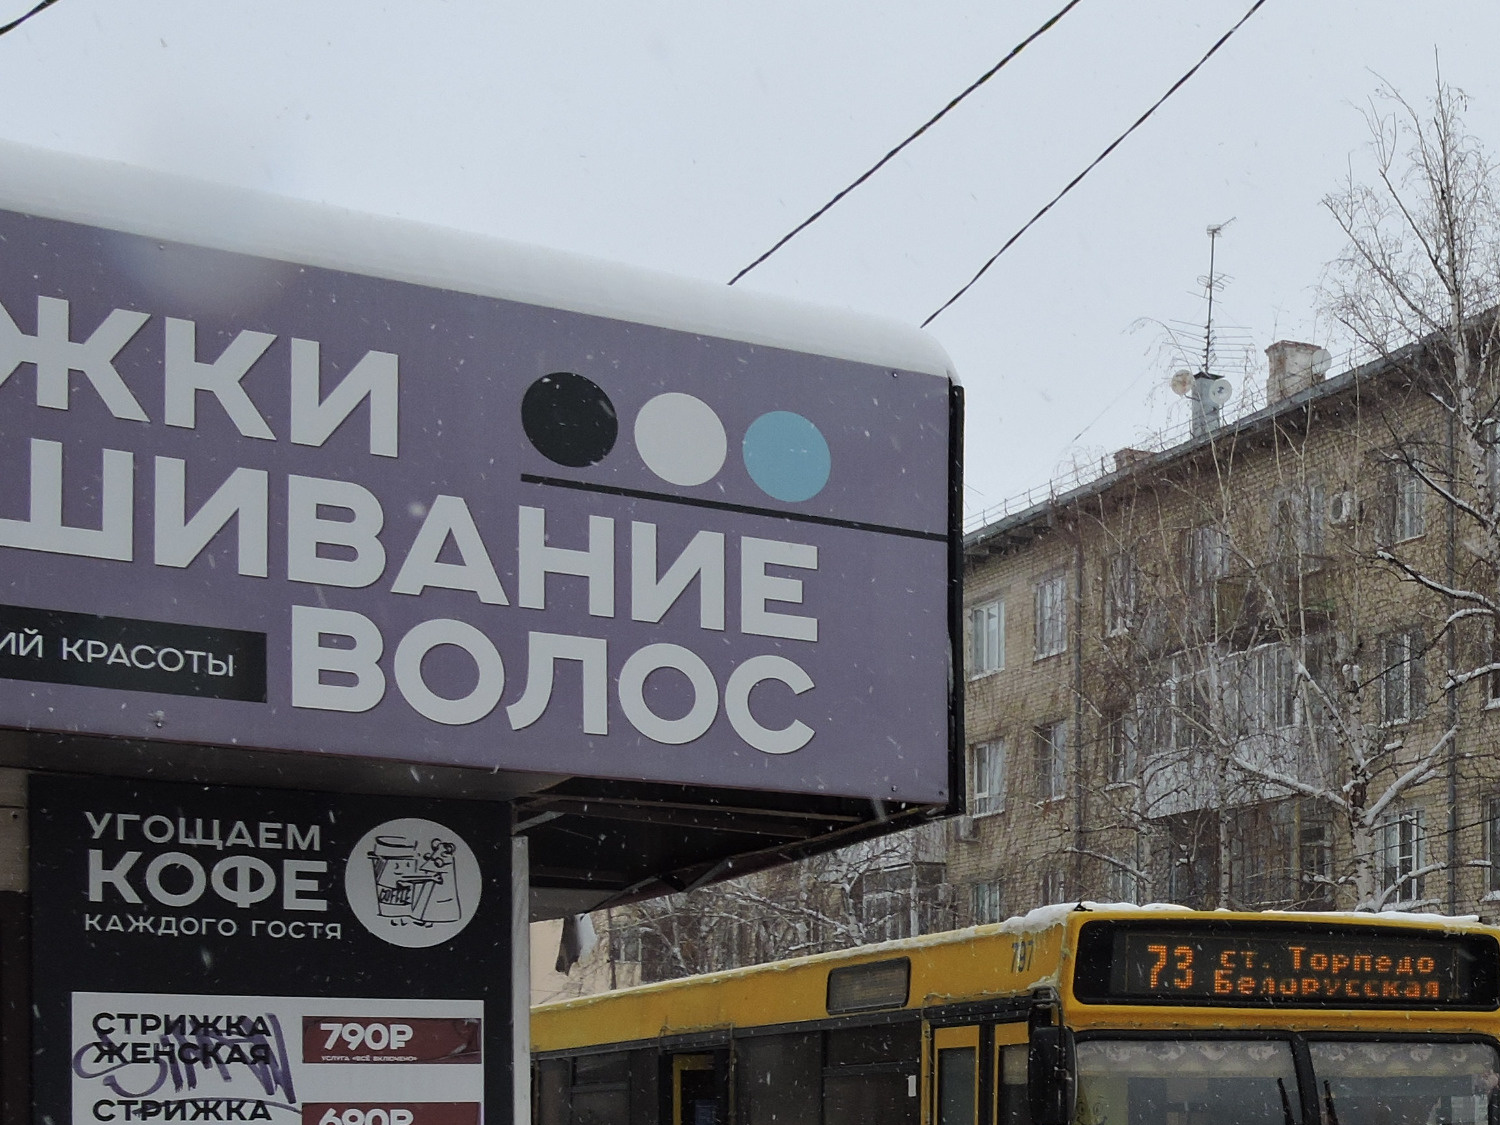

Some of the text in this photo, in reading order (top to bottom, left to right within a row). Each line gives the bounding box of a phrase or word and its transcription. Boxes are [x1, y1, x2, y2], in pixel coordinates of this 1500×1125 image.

[0, 296, 398, 458] ЖКИ
[0, 438, 818, 642] ШИВАНИЕ
[62, 637, 234, 677] КРАСОТЫ
[290, 605, 816, 755] ВОЛОС
[85, 811, 320, 851] УГОЩАЕМ
[88, 849, 328, 911] КОФЕ
[85, 913, 341, 940] КАЖДОГО ГОСТЯ
[1010, 939, 1034, 973] 797
[1147, 945, 1194, 989] 73
[1219, 946, 1436, 975] ст. Торпедо
[1214, 969, 1440, 998] Белорусская
[92, 1012, 414, 1051] СТРИЖКА 790₽
[93, 1042, 271, 1065] ЖЕНСКАЯ
[92, 1100, 272, 1121] СТРИЖКА
